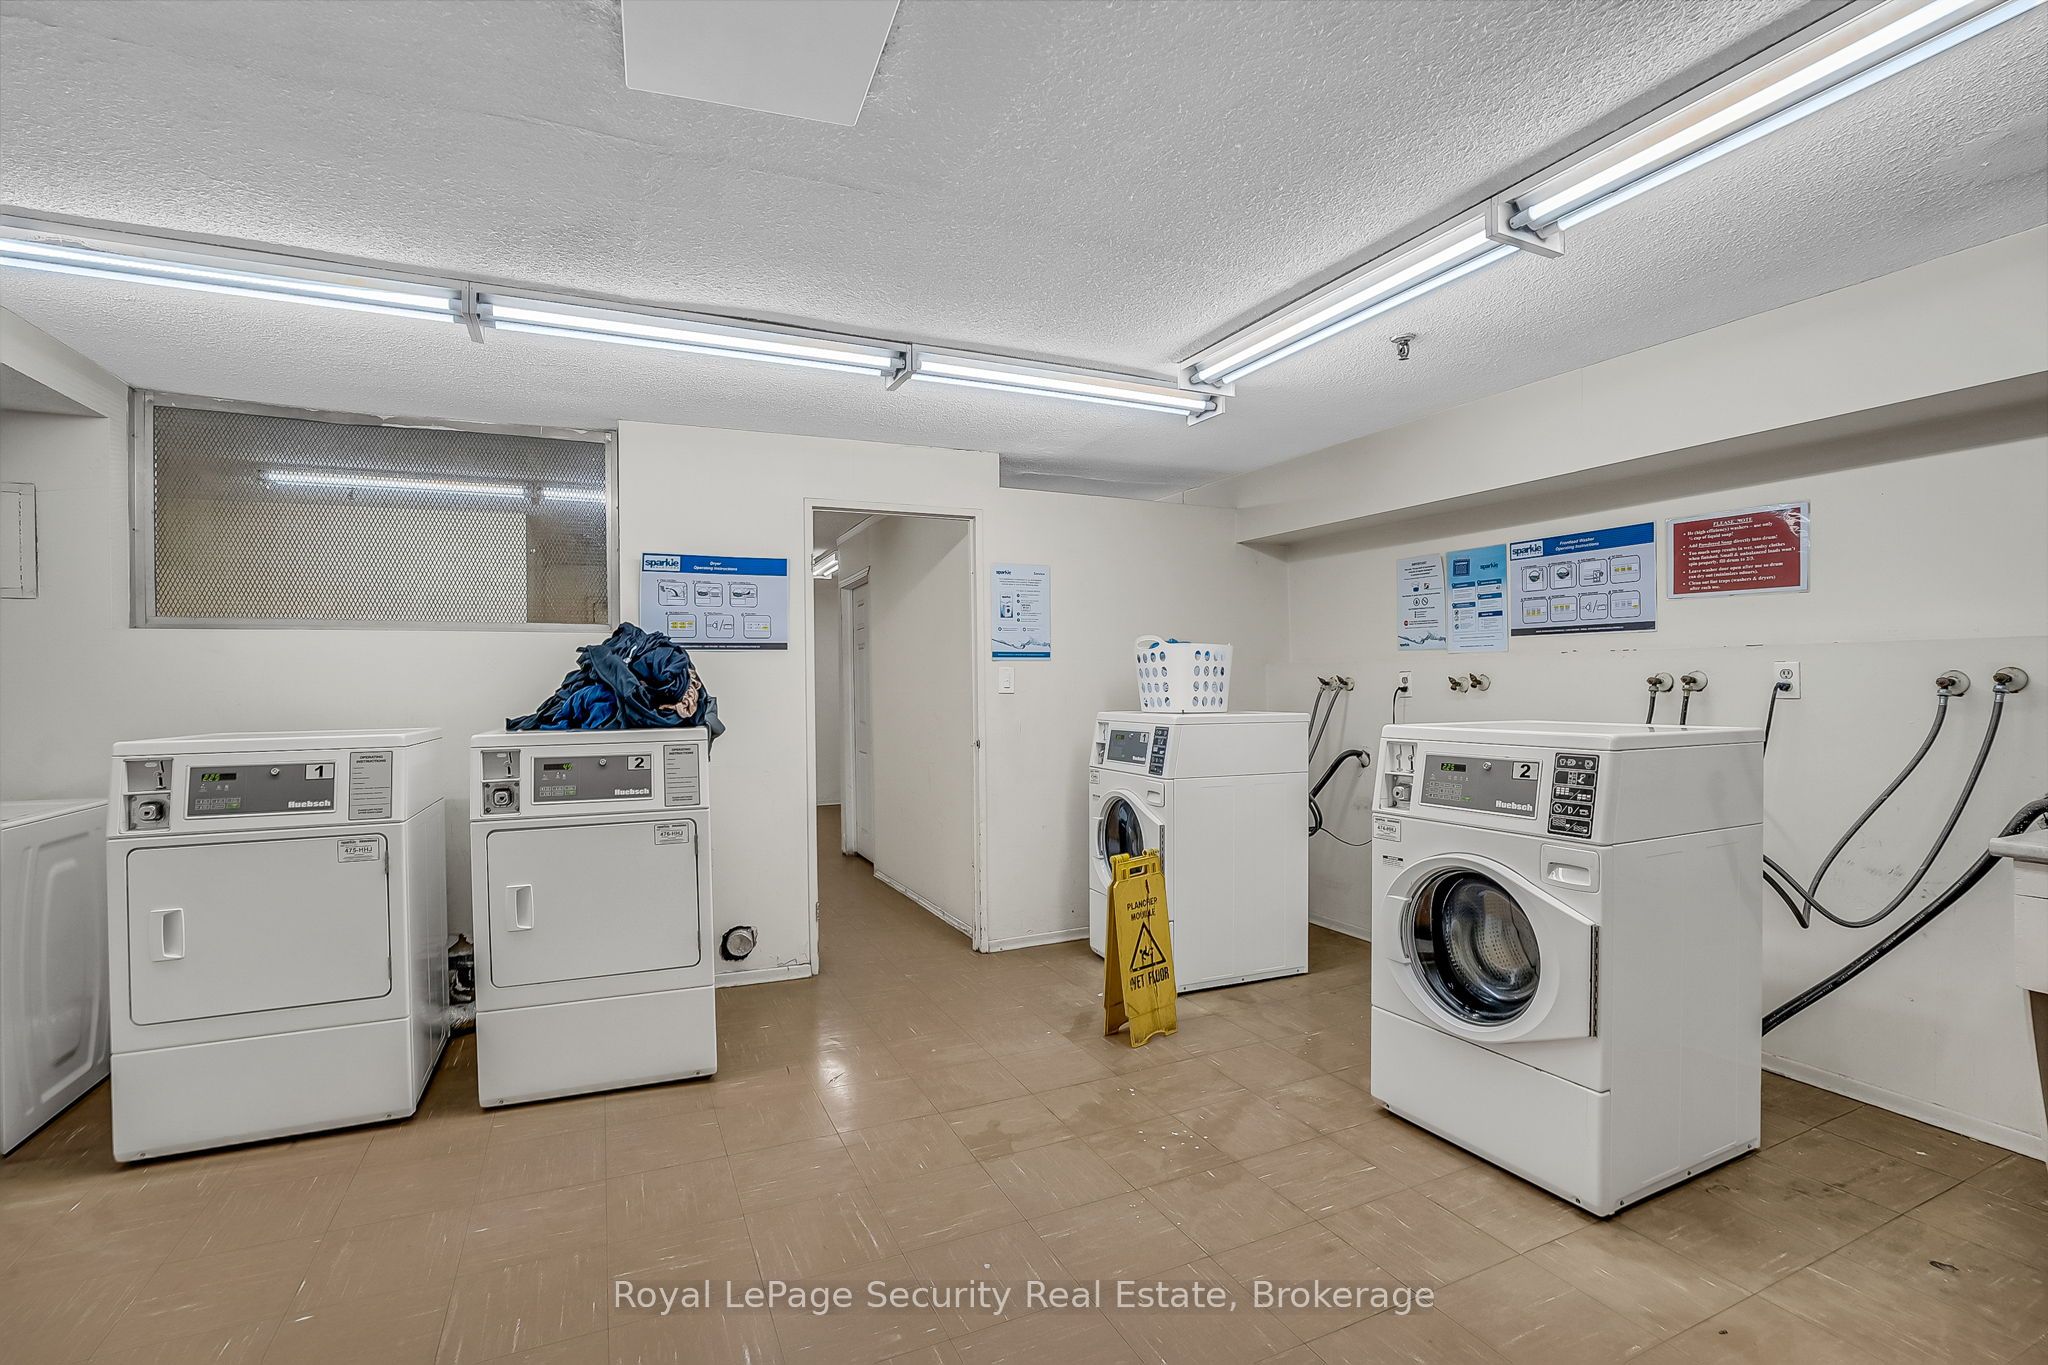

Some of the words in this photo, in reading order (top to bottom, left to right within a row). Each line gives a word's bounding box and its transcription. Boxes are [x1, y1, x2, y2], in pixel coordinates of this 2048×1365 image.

[1512, 543, 1542, 557] sparkle
[1575, 541, 1600, 549] Instructions
[645, 558, 679, 568] sparkle
[1480, 562, 1498, 571] sparkle
[634, 757, 645, 769] 2
[314, 765, 324, 778] 1
[1519, 763, 1531, 779] 2
[614, 788, 650, 796] Huebsch
[287, 799, 331, 808] Huebsch
[1495, 800, 1533, 812] Huebsch
[1148, 967, 1170, 985] FLOOR
[1130, 974, 1144, 991] WET
